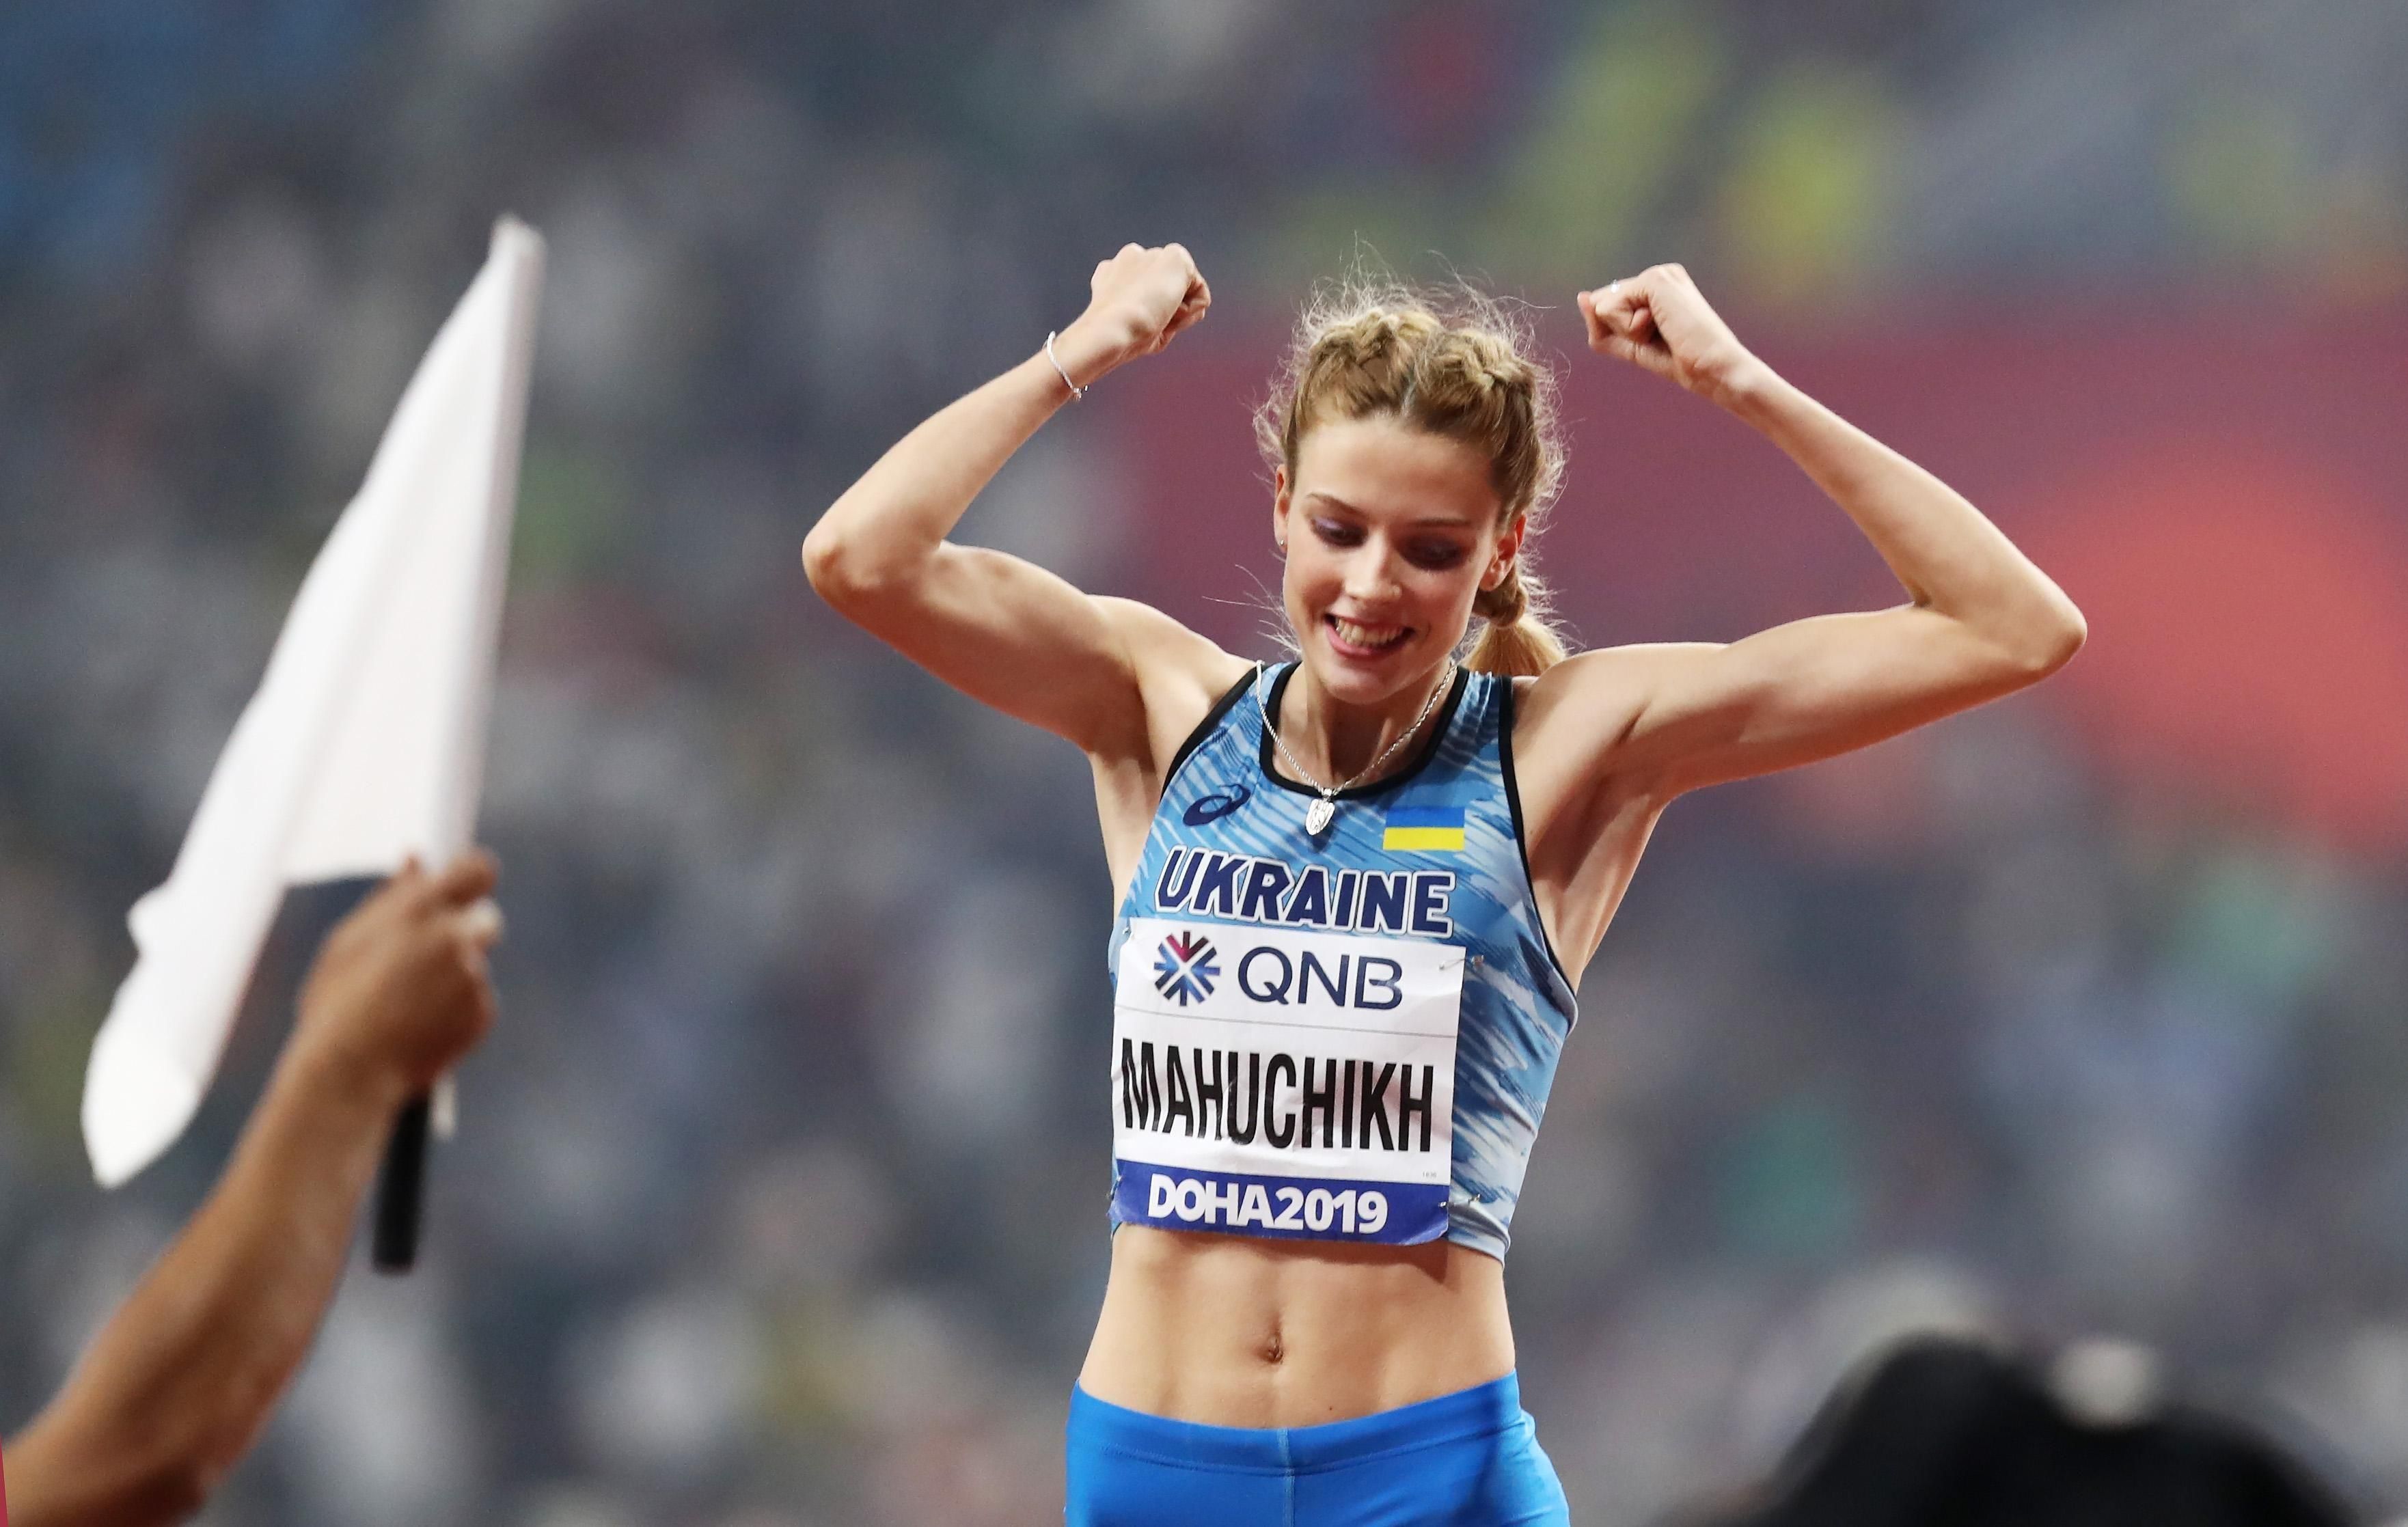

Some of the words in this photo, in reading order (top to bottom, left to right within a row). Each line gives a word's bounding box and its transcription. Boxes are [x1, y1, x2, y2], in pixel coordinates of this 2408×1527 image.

[1155, 846, 1455, 938] UKRAINE
[1238, 947, 1403, 1010] QNB
[1122, 1038, 1434, 1151] MAHUCHIKH
[1148, 1173, 1388, 1234] DOHA2019
